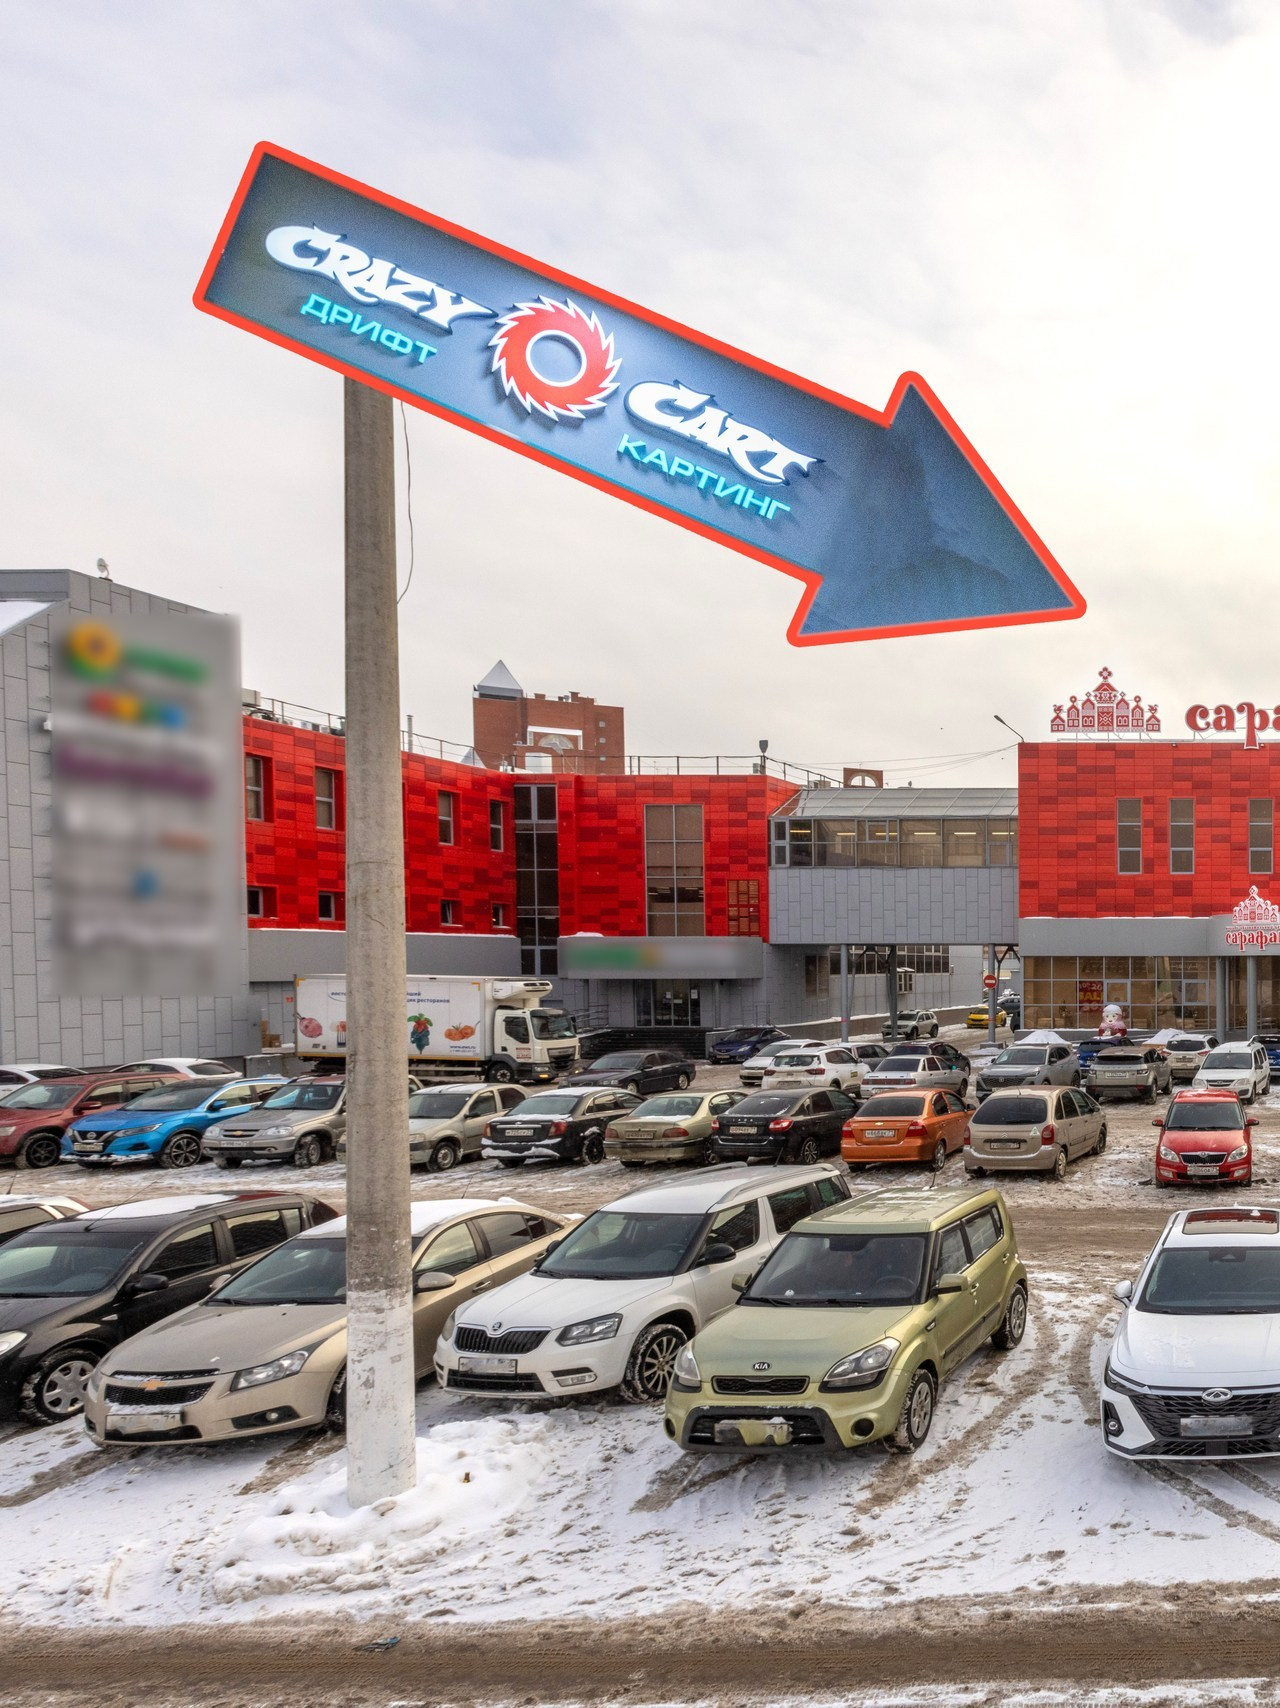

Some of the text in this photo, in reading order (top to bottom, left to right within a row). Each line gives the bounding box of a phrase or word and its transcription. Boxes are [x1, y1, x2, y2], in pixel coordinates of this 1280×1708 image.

[265, 224, 497, 331] CRAZY
[301, 294, 437, 364] ДРИФТ
[617, 433, 791, 519] КАРТИНГ
[626, 381, 821, 484] CART
